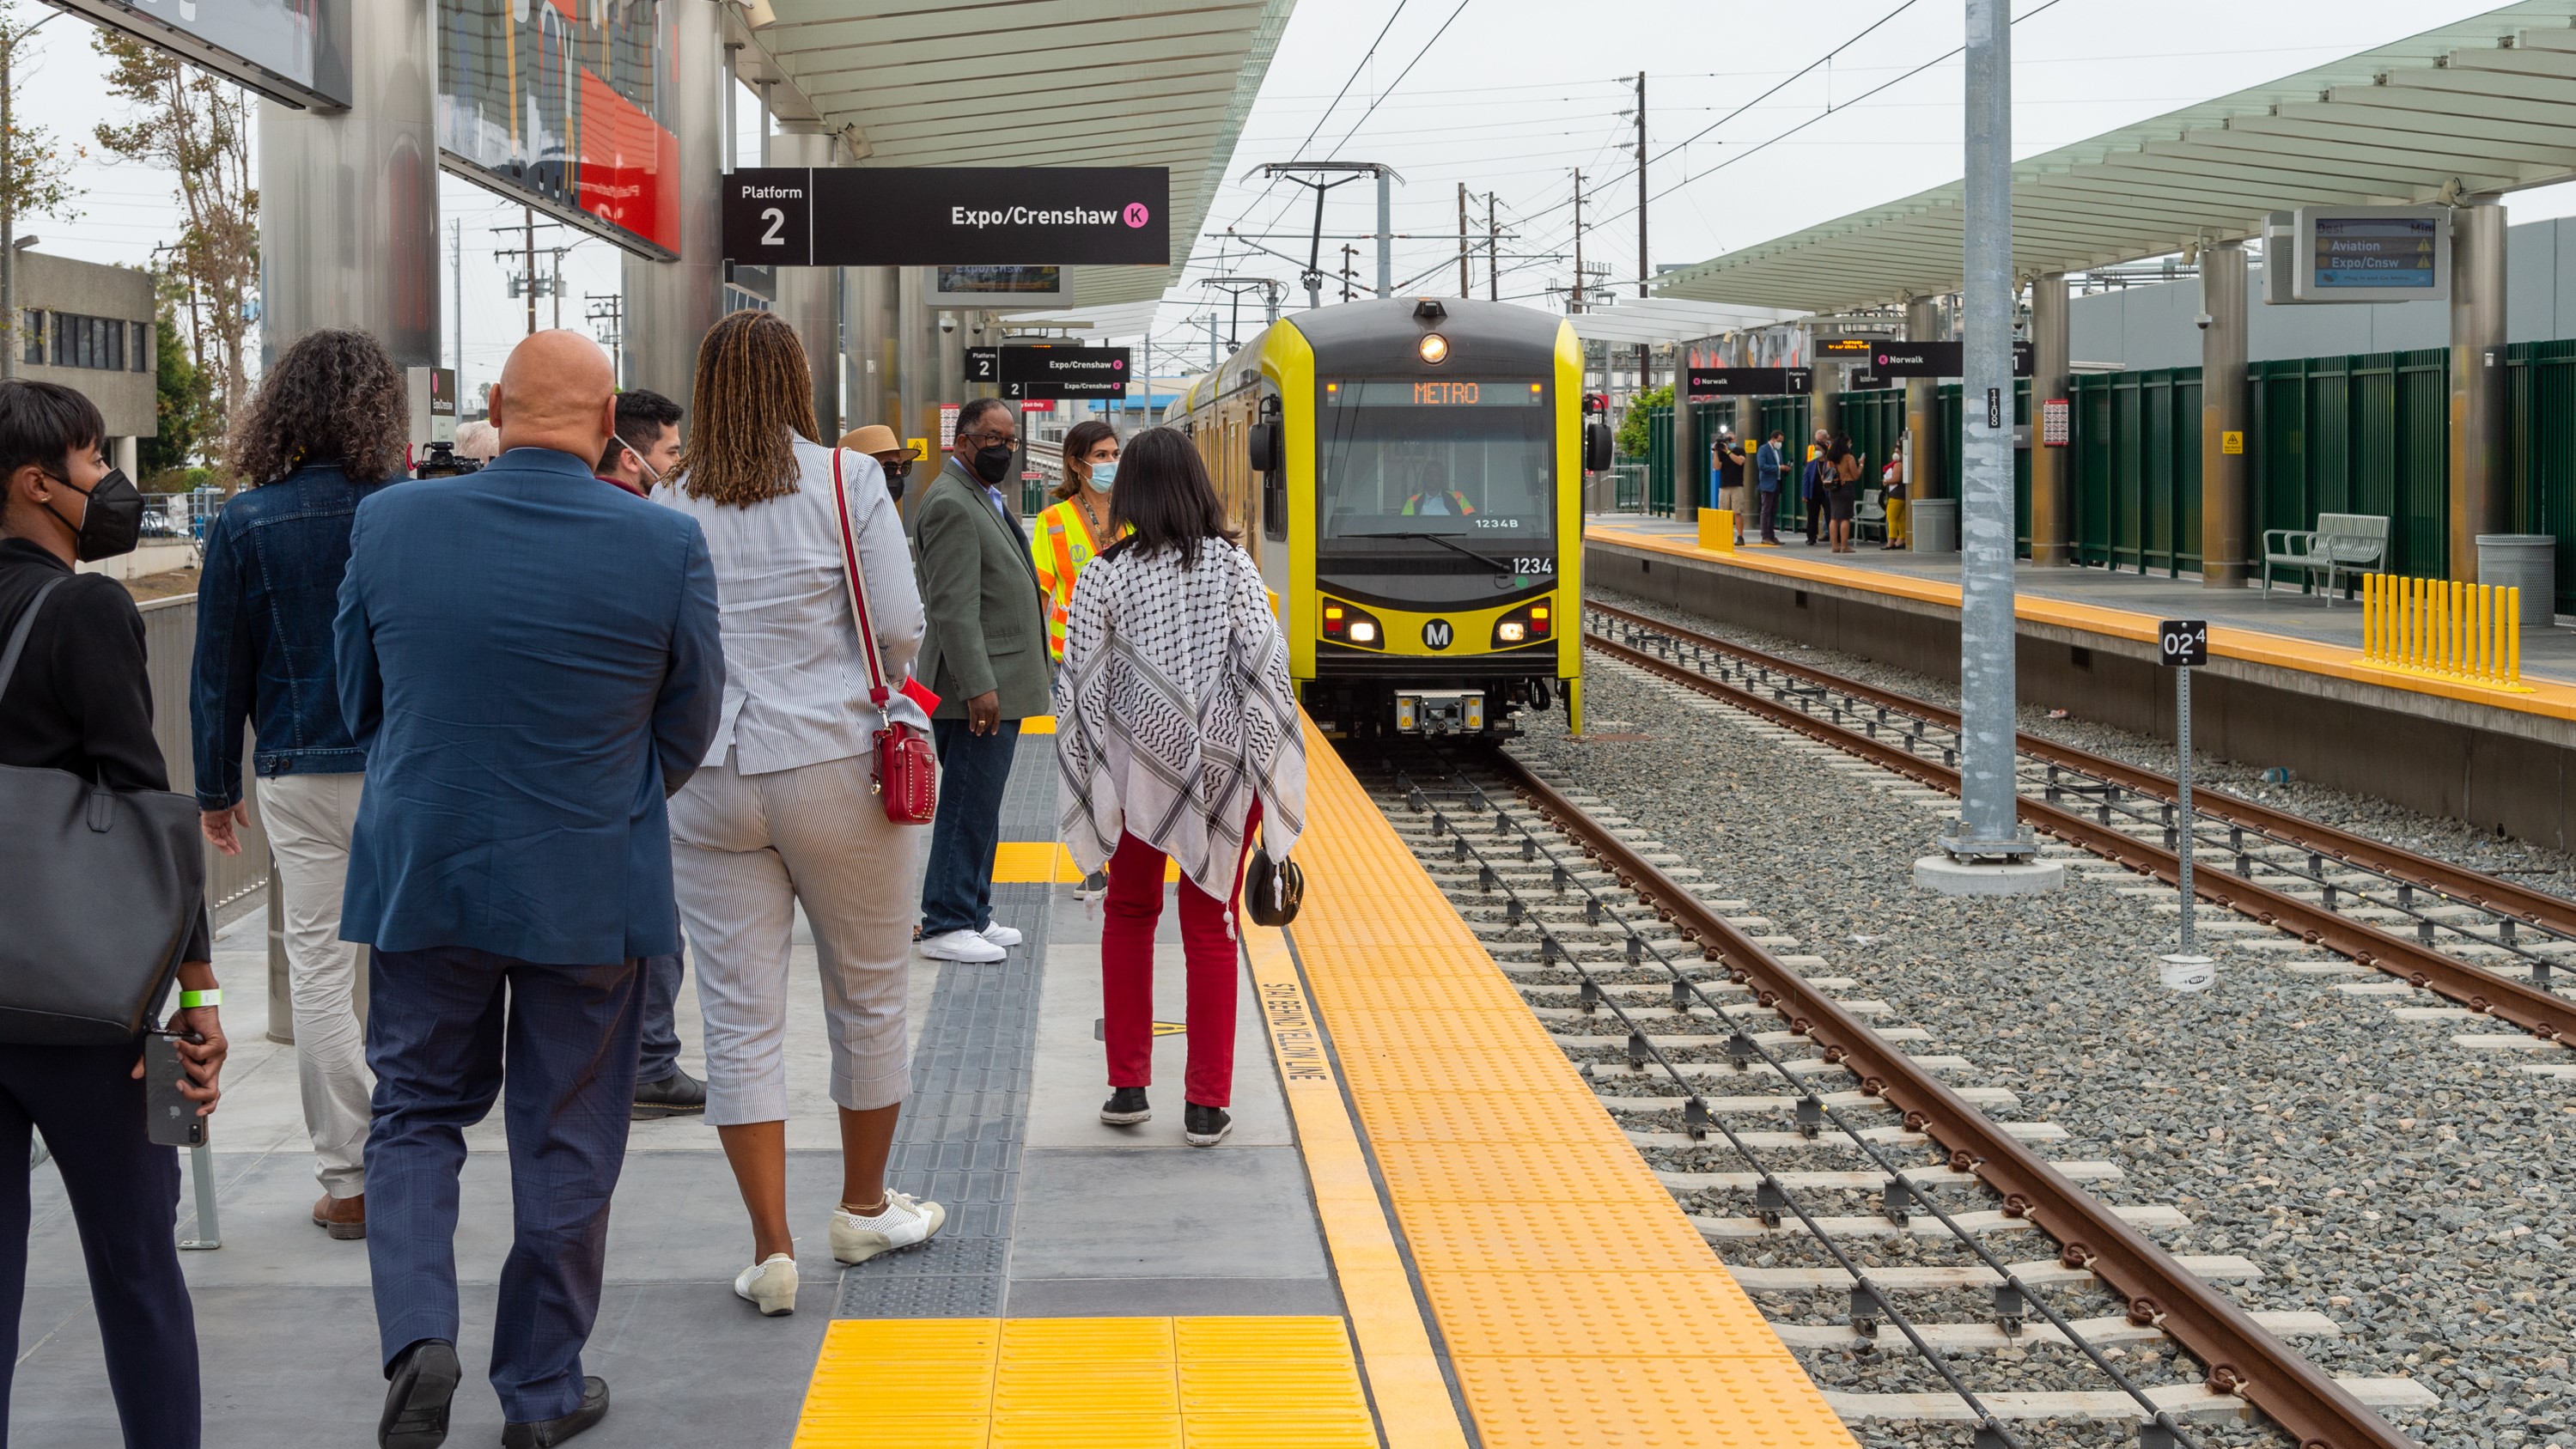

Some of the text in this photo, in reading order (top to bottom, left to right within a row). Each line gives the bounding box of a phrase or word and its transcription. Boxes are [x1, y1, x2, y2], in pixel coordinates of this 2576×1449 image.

[741, 186, 802, 198] Platform
[951, 206, 1142, 228] Expo/Crenshaw K
[761, 207, 785, 246] 2
[2317, 223, 2344, 234] Dest
[2331, 240, 2380, 252] Aviation
[2331, 257, 2399, 270] Expo/Cnsw
[1049, 361, 1111, 370] Expo/Crenshaw
[1890, 355, 1923, 364] Norwalk
[2012, 355, 2019, 370] 1
[979, 361, 990, 376] 2
[1011, 383, 1020, 395] 2
[1064, 382, 1111, 391] Expo/Crenshaw
[1794, 377, 1800, 389] 1
[1414, 382, 1479, 405] METRO
[1990, 389, 1999, 426] 1108
[1475, 519, 1519, 528] 1234B
[1071, 546, 1083, 560] M
[1513, 557, 1553, 574] 1234
[1427, 624, 1448, 645] M
[1263, 983, 1327, 1081] STAY BEHIND YELLOW LINE
